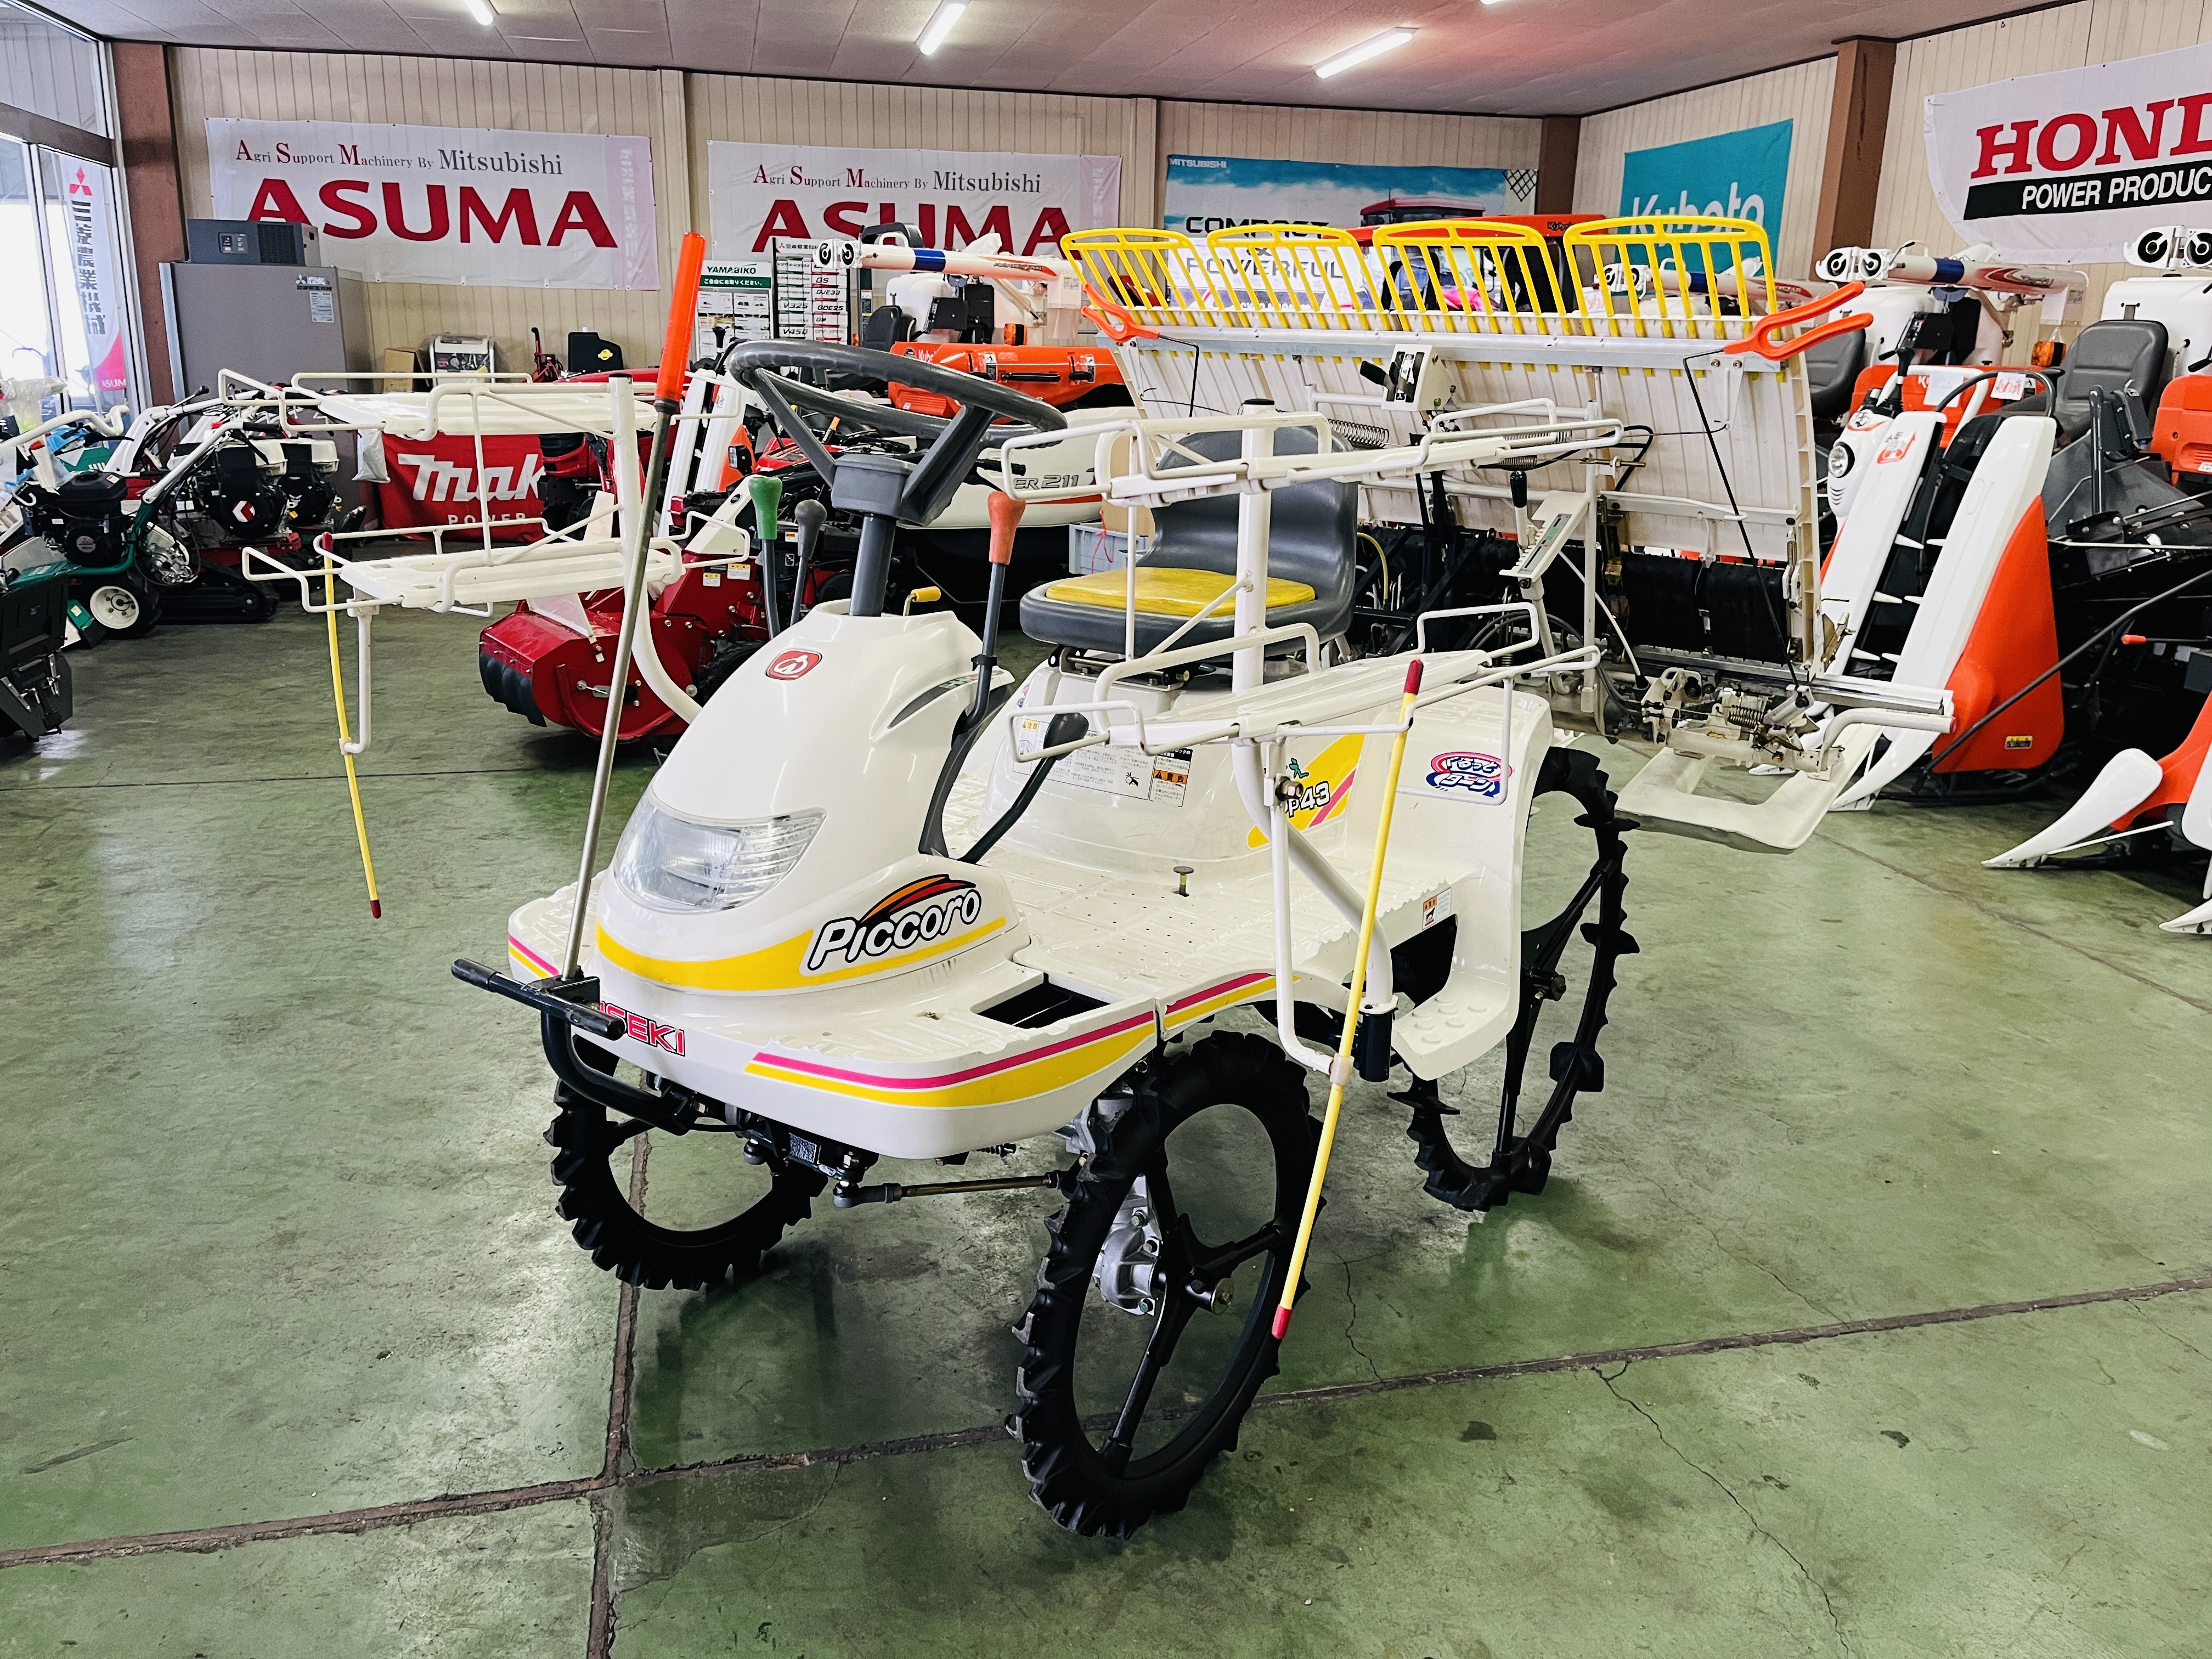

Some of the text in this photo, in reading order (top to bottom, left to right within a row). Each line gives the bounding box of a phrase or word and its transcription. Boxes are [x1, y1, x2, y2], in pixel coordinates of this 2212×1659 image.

[236, 139, 563, 174] Agri Support Machinery By Mitsubishi
[1169, 158, 1227, 168] MITSUBISHI
[753, 165, 1041, 193] Agri Support Machinery By Mitsubishi
[2022, 180, 2101, 210] POWER
[247, 178, 618, 247] ASUMA
[752, 200, 1082, 261] ASUMA
[71, 200, 106, 335] 三菱農業機械
[707, 266, 756, 274] YAMABIKO
[1285, 781, 1330, 818] P43
[808, 889, 982, 970] Piccoro
